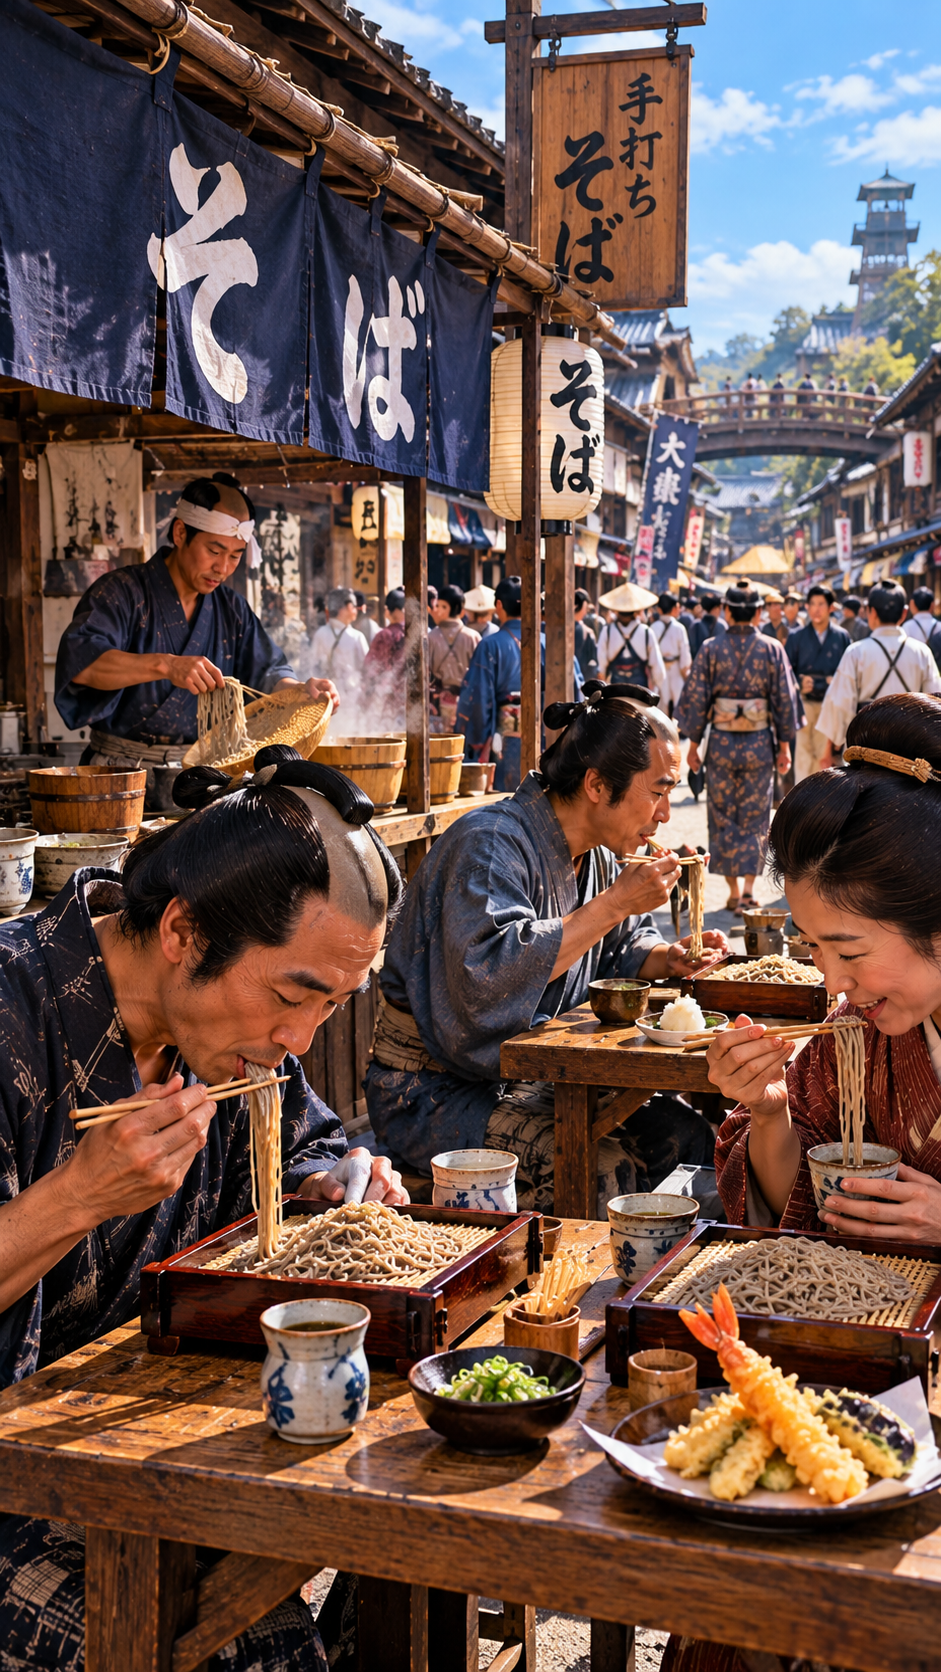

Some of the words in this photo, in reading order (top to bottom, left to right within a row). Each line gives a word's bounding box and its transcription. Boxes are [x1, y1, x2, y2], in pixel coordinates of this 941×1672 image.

[554, 130, 624, 284] そば
[619, 72, 664, 219] 手打ち
[147, 143, 426, 443] そば
[550, 358, 601, 495] そば
